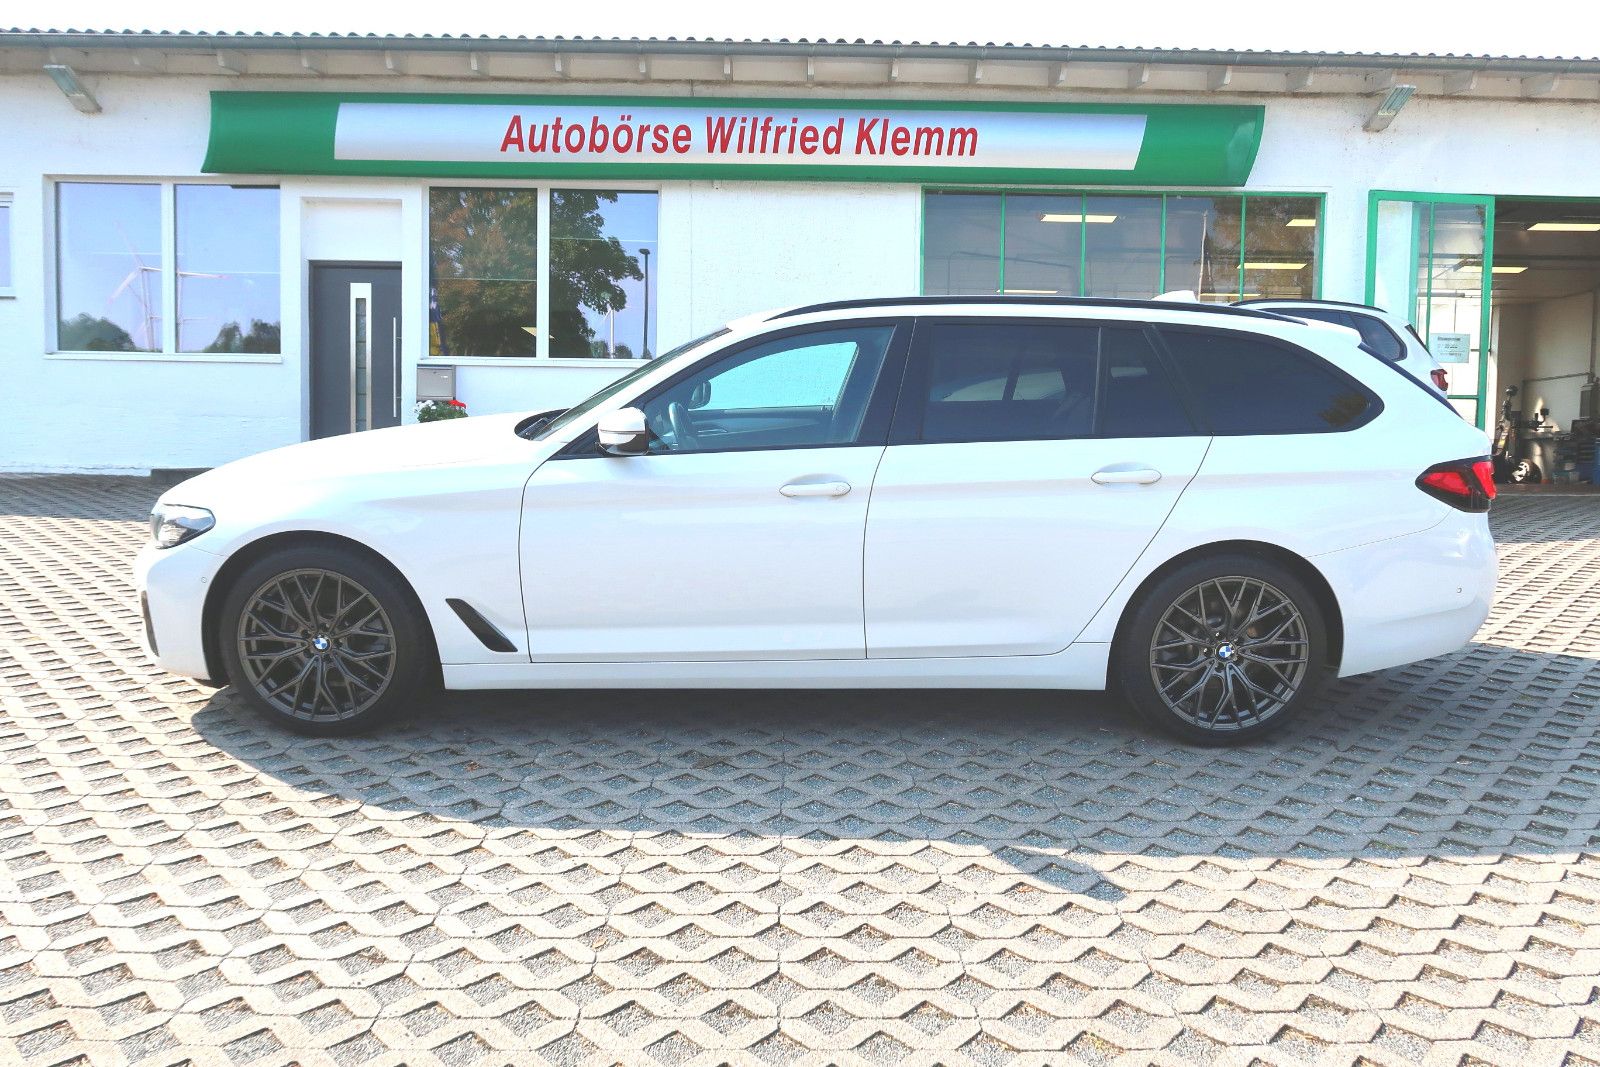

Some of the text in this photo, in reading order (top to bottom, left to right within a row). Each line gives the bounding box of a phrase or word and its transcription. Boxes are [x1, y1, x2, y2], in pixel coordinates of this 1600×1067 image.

[500, 115, 978, 157] Autobörse Wilfried Klemm
